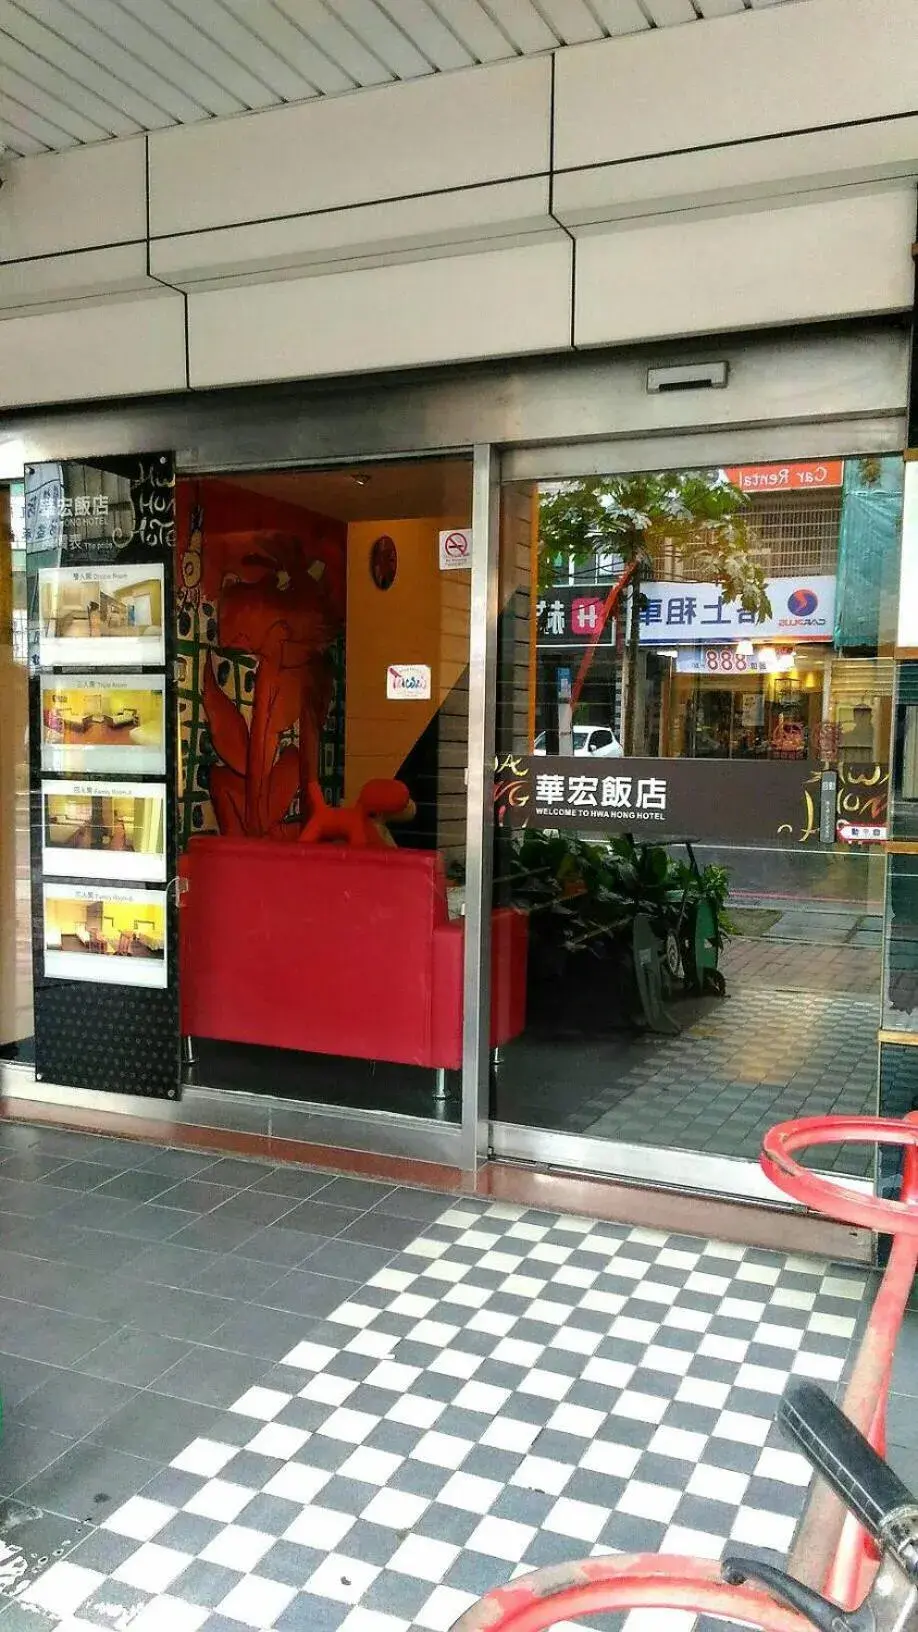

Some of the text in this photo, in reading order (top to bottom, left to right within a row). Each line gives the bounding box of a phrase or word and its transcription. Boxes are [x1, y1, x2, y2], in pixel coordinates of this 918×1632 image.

[83, 516, 109, 527] HOTEL
[535, 773, 667, 811] 華宏飯店
[535, 807, 577, 818] WELCOME
[577, 809, 590, 818] TO
[590, 809, 610, 819] HWA
[611, 810, 636, 820] HONG
[637, 811, 666, 821] HOTEL
